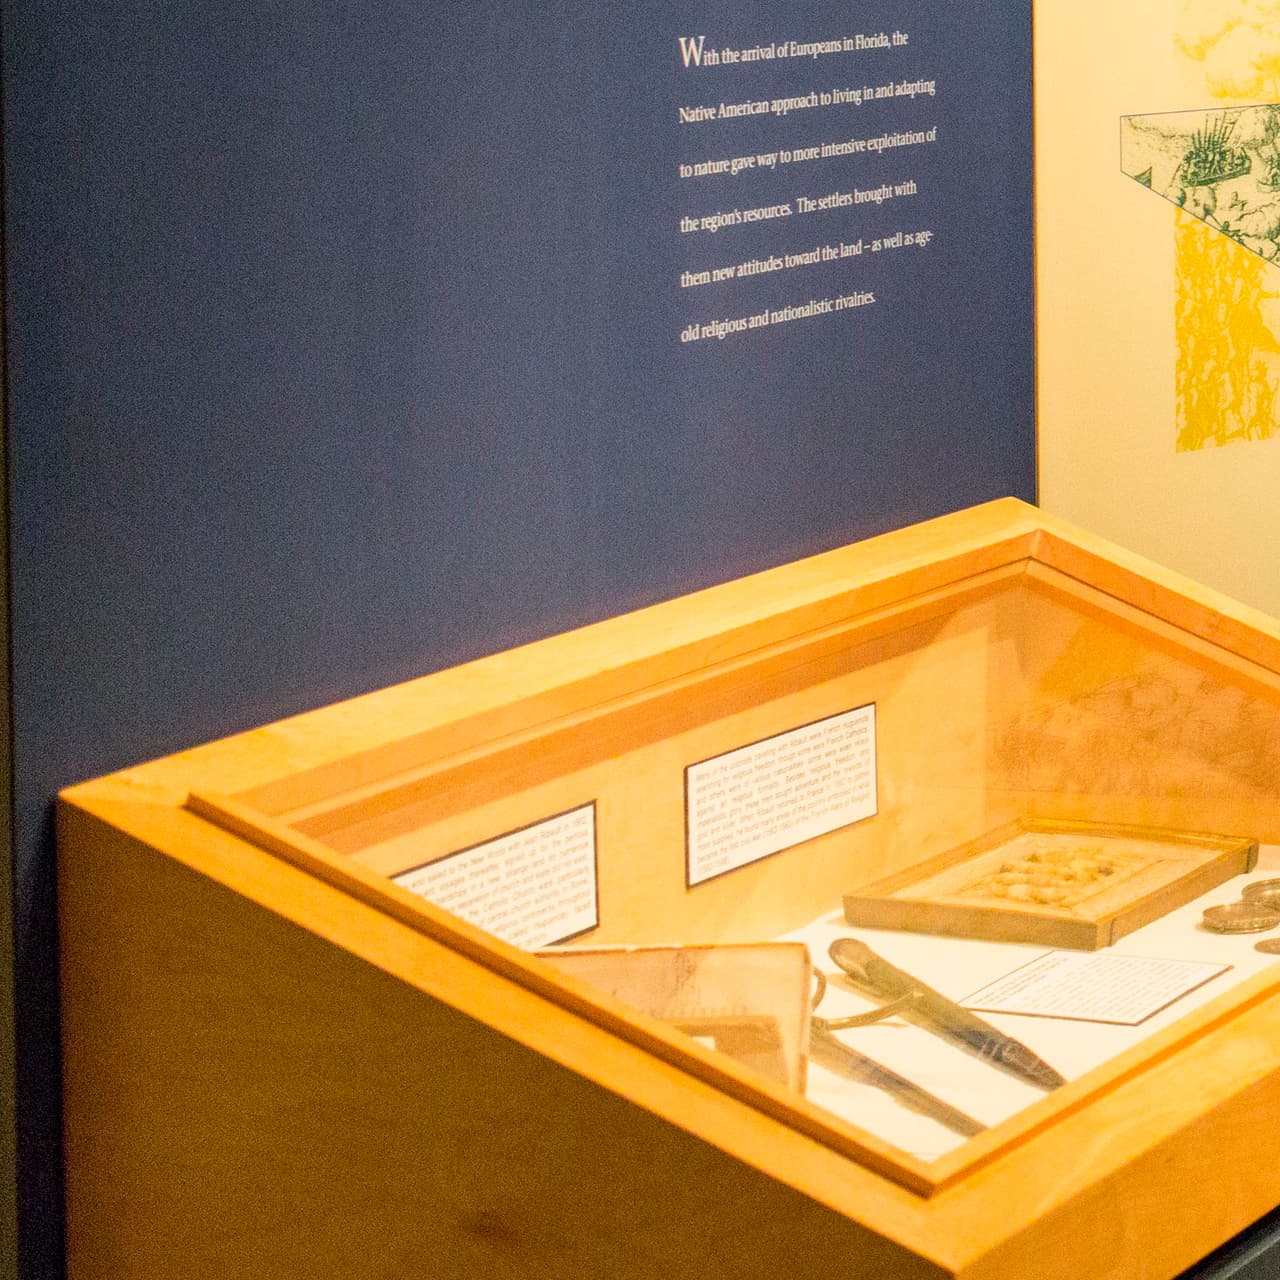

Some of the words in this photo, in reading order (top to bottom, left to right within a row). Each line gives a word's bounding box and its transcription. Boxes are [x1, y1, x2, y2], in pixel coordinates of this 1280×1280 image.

[678, 36, 720, 67] With
[721, 47, 740, 63] the
[741, 43, 775, 61] arrival
[776, 42, 788, 58] of
[789, 40, 842, 59] Europeans
[843, 36, 854, 52] in
[855, 33, 891, 52] Florida,
[892, 31, 909, 47] the
[678, 105, 716, 123] Native
[717, 100, 770, 118] American
[771, 92, 818, 115] approach
[819, 91, 831, 107] to
[832, 88, 861, 106] living
[863, 86, 873, 102] in
[874, 83, 893, 100] and
[894, 80, 936, 100] adapting
[679, 162, 692, 177] to
[693, 158, 730, 175] nature
[730, 156, 755, 174] gave
[756, 152, 778, 168] way
[779, 148, 792, 163] to
[793, 147, 820, 161] more
[821, 138, 866, 157] intensive
[867, 129, 925, 153] exploitation
[925, 126, 938, 142] of
[679, 216, 699, 232] the
[700, 209, 742, 231] region's
[743, 203, 792, 222] resources.
[796, 196, 817, 213] The
[817, 191, 853, 209] settlers
[854, 182, 893, 204] brought
[894, 178, 918, 196] with
[680, 270, 711, 287] them
[712, 267, 735, 281] new
[736, 256, 783, 277] attitudes
[784, 247, 820, 268] toward
[821, 244, 839, 261] the
[840, 239, 862, 257] land
[871, 239, 882, 251] as
[883, 231, 903, 249] well
[904, 233, 914, 245] as
[915, 229, 934, 246] age-
[680, 324, 700, 342] old
[701, 317, 748, 337] religious
[748, 309, 770, 327] and
[771, 296, 834, 323] nationalistic
[834, 289, 876, 309] rivalries.
